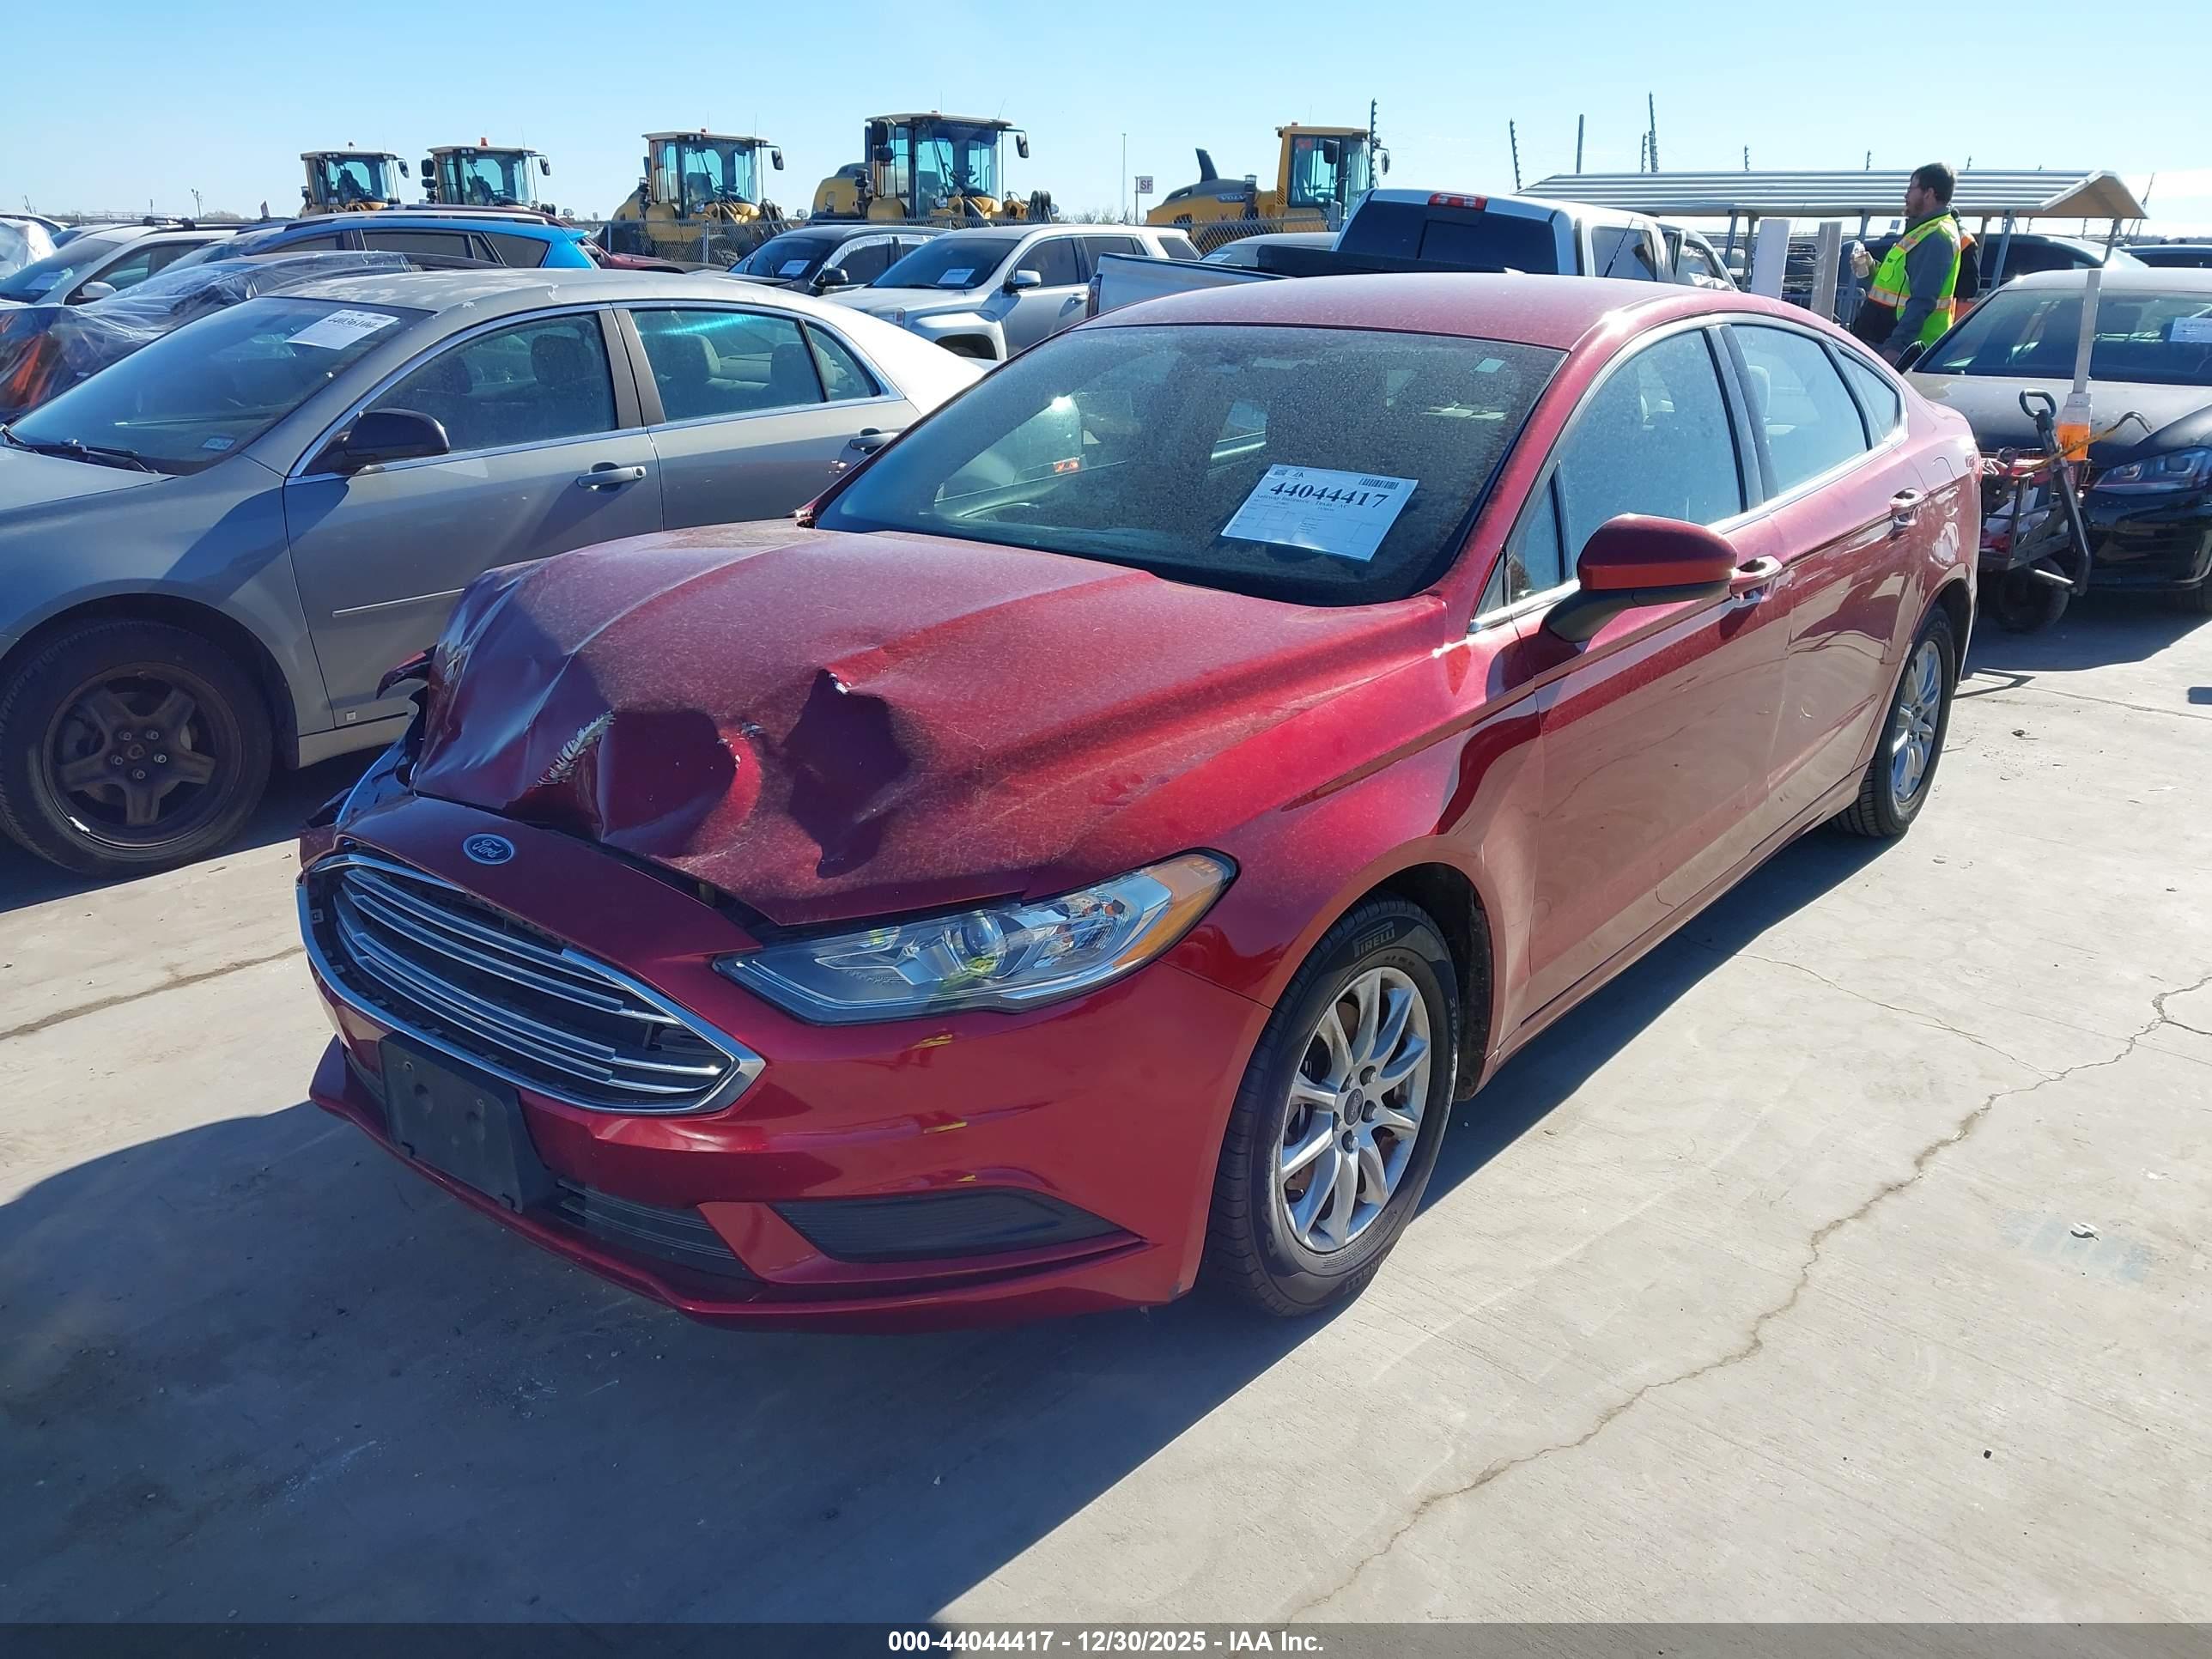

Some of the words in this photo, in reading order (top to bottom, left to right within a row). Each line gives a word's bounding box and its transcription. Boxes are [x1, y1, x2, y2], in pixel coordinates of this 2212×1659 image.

[1140, 179, 1152, 190] SF
[1270, 482, 1389, 508] 44044417
[1352, 921, 1395, 957] PIRELLI
